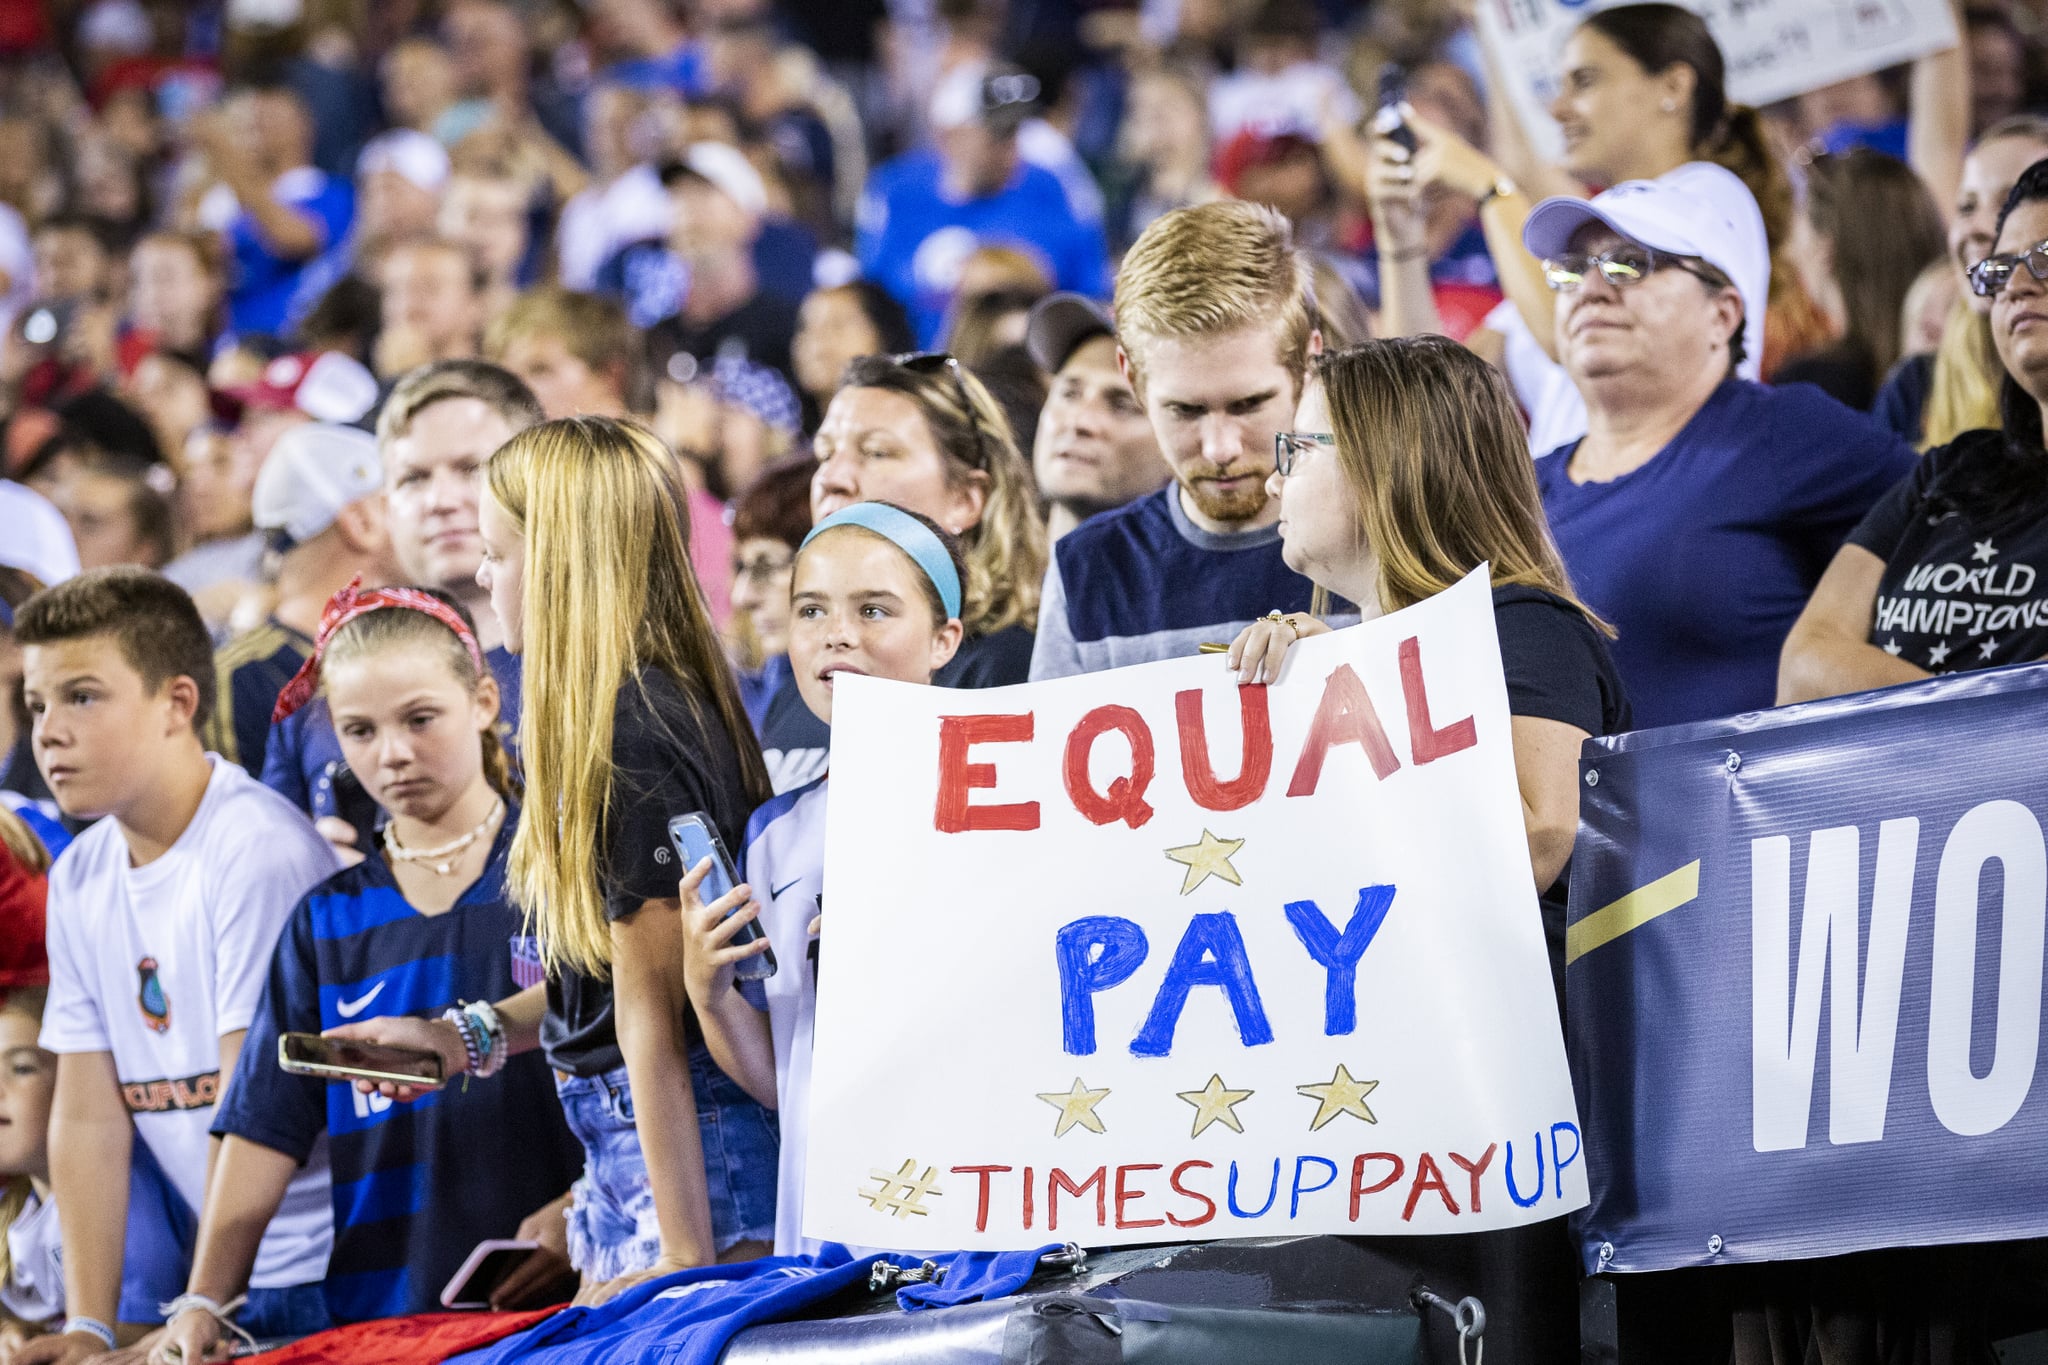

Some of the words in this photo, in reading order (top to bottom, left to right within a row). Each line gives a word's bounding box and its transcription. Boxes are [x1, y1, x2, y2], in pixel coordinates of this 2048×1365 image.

[1903, 563, 2036, 596] WORLD
[935, 635, 1477, 834] EQUAL
[1055, 884, 1397, 1058] PAY
[1751, 799, 2047, 1152] WO
